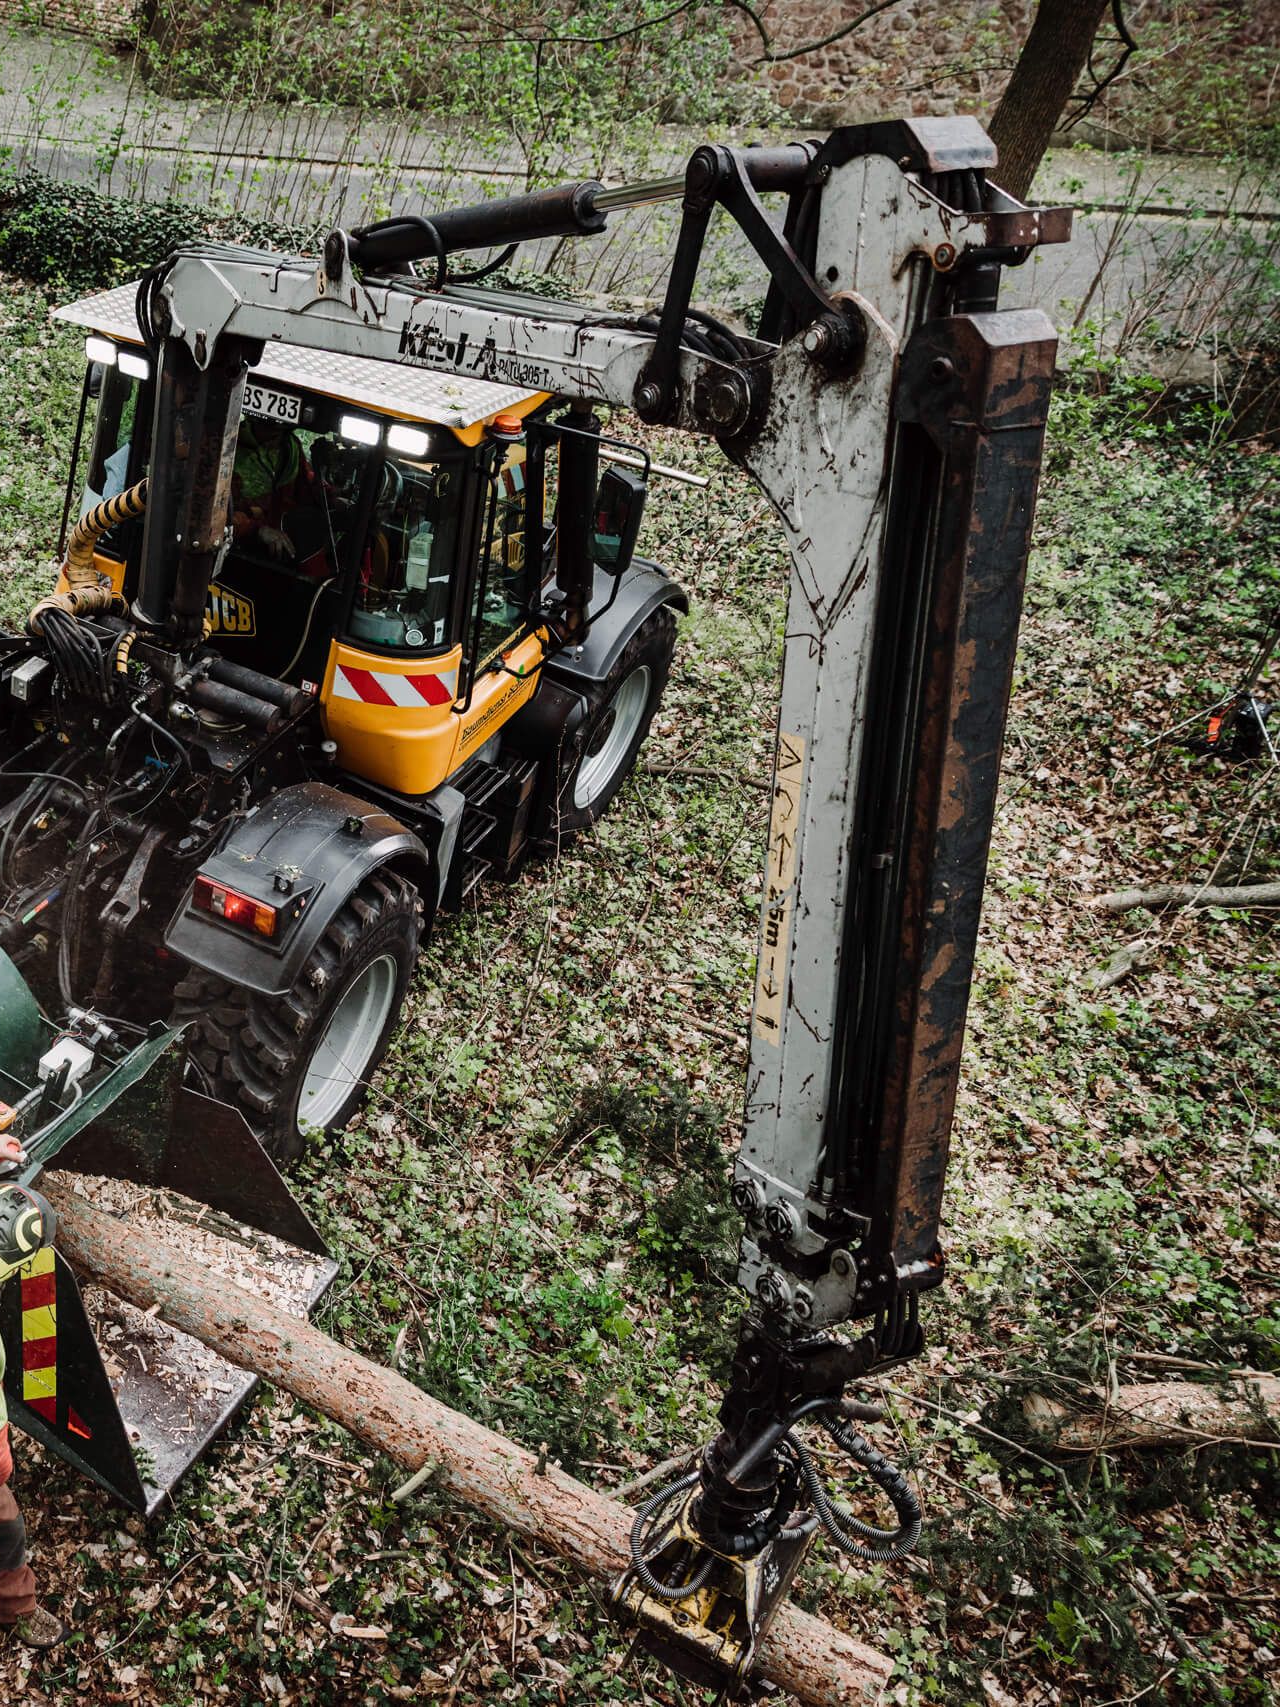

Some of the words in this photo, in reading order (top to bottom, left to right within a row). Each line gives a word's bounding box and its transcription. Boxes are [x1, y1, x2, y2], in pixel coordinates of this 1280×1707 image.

[242, 386, 263, 410] BS
[267, 393, 299, 419] 783
[205, 584, 251, 631] JCB
